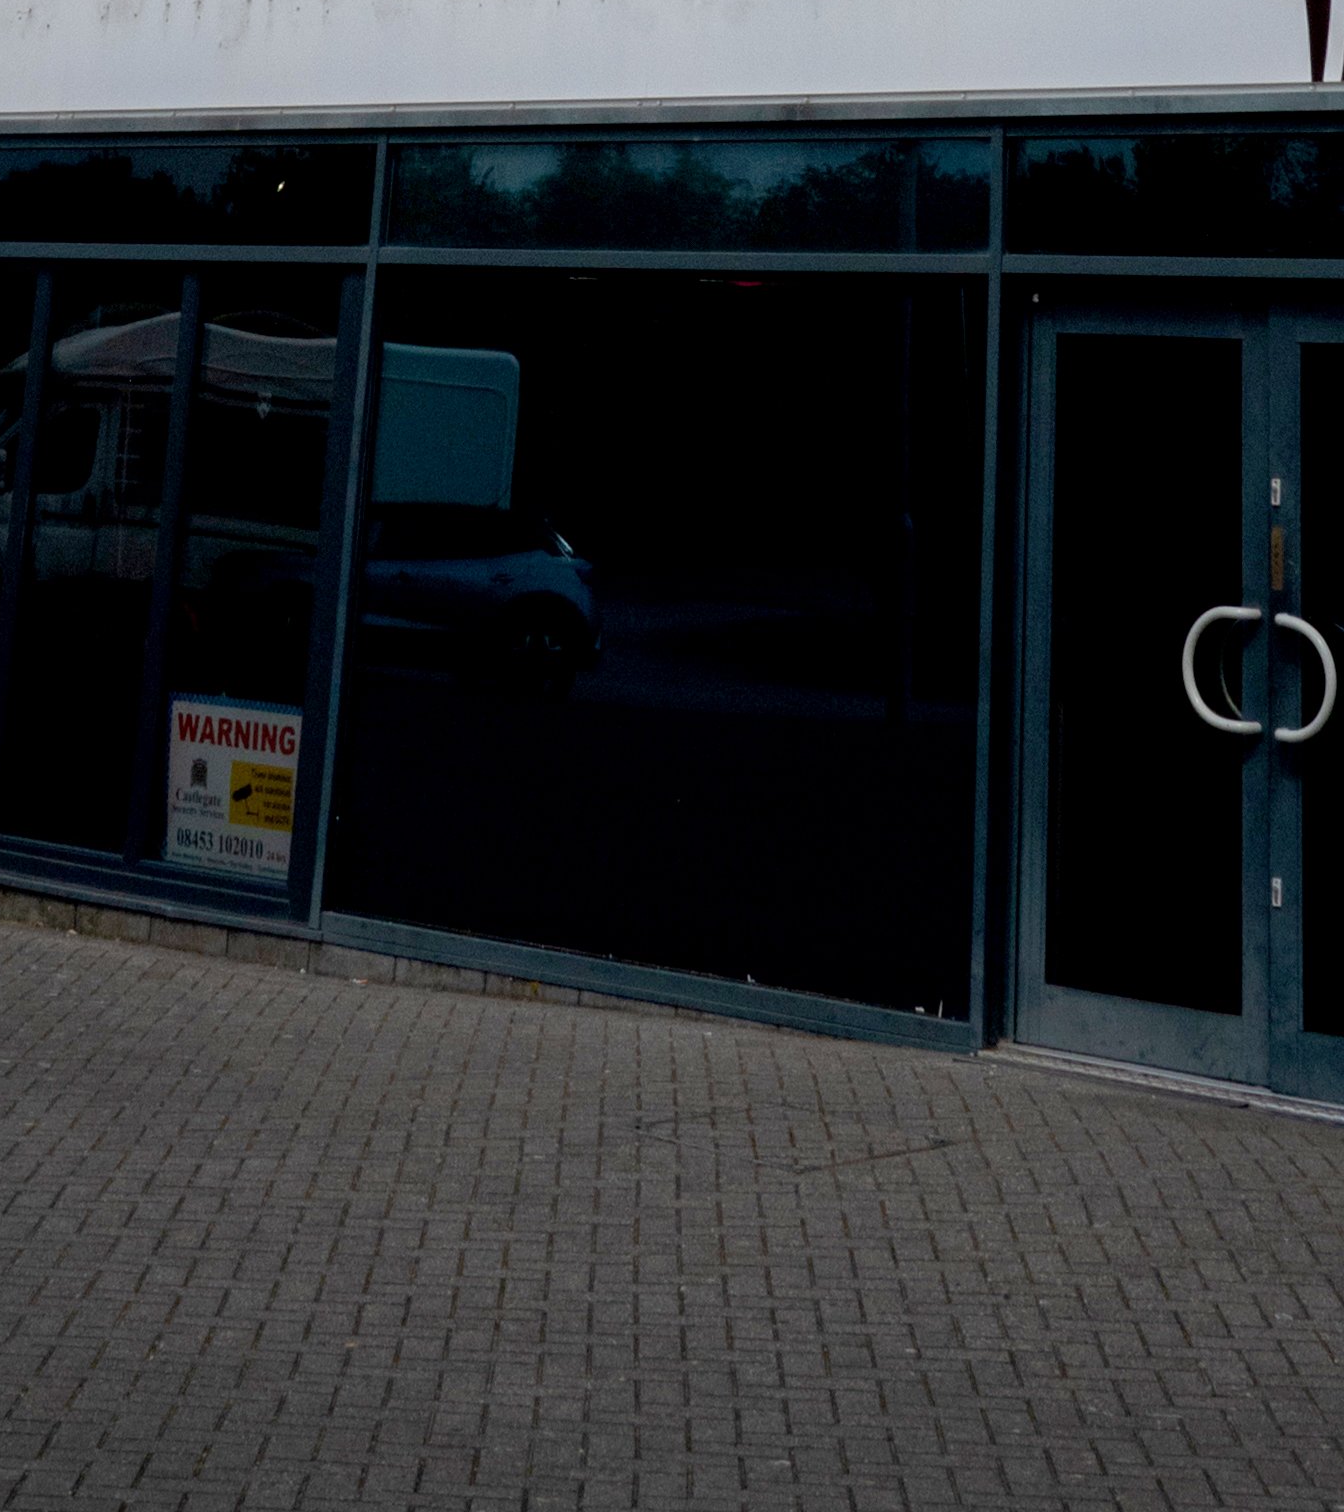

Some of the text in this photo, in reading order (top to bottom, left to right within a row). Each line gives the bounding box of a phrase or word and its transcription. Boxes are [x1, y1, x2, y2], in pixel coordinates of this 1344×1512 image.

[177, 711, 296, 755] WARNING
[175, 786, 222, 807] Castlegate
[176, 827, 214, 851] 08453
[218, 834, 264, 859] 102010
